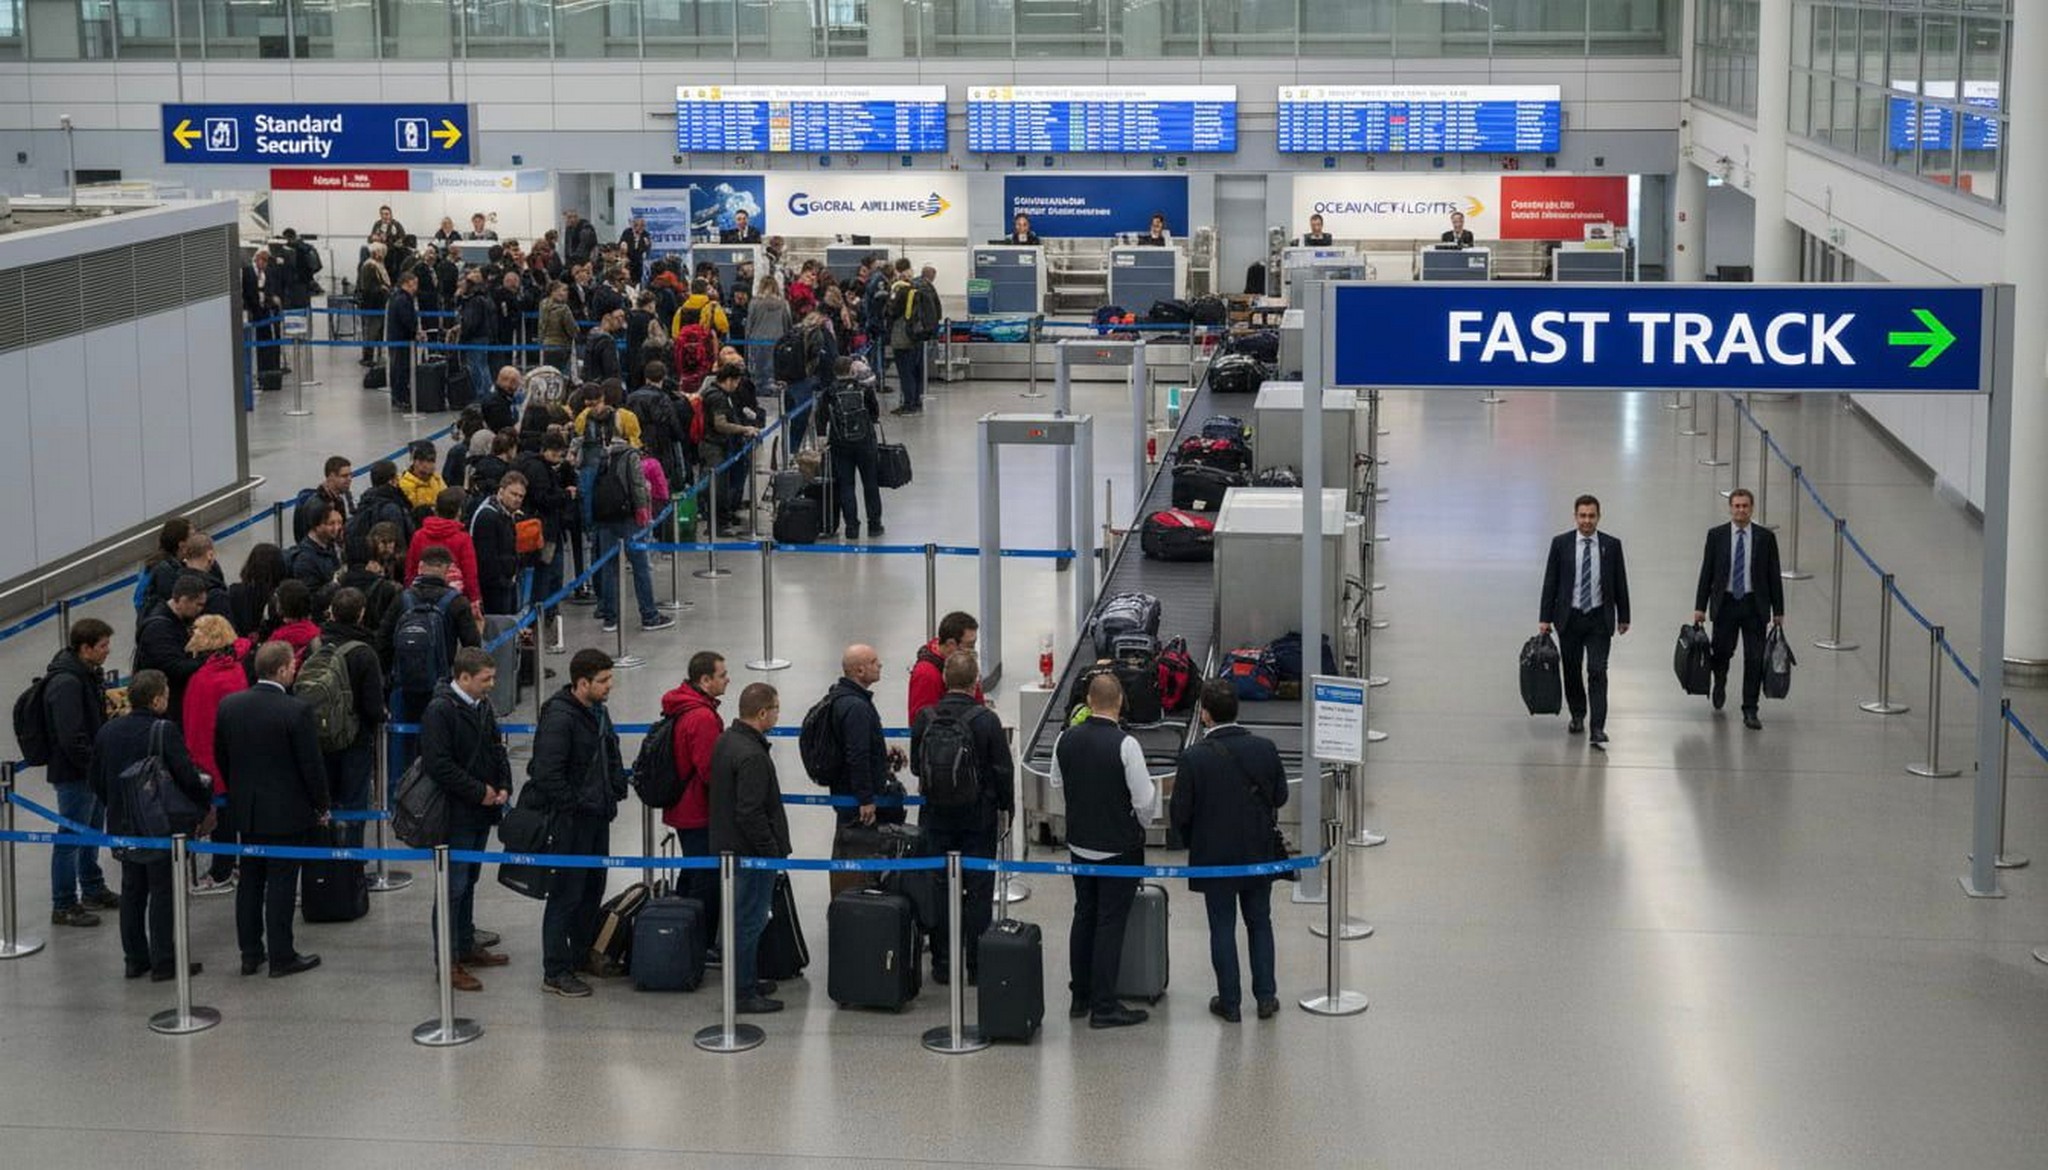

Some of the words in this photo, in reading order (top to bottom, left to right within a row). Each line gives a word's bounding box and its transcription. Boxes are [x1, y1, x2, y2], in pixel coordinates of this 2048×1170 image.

[254, 113, 343, 134] Standard
[256, 135, 333, 159] Security
[1447, 310, 1610, 364] FAST
[1628, 312, 1857, 367] TRACK
